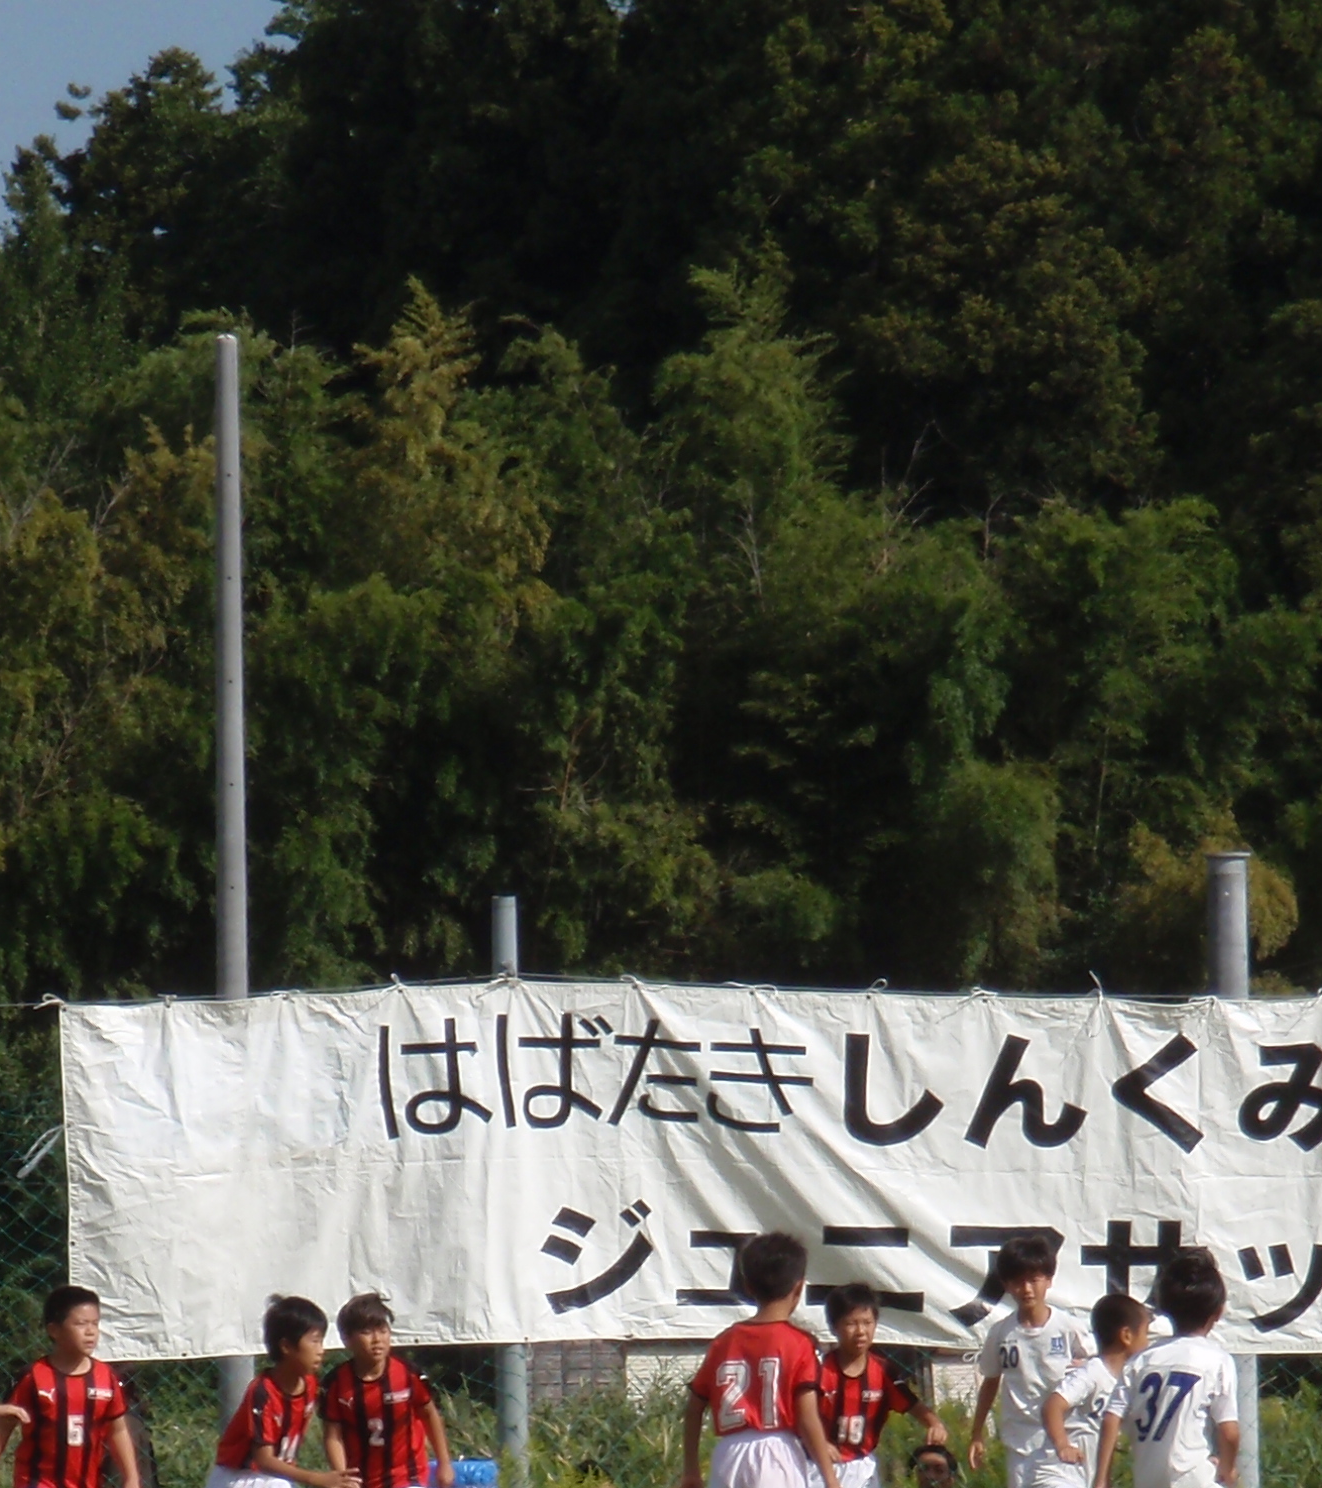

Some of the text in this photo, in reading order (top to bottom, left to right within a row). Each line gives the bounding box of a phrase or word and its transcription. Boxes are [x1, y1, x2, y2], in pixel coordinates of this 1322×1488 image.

[1000, 1345, 1020, 1368] 20
[716, 1358, 781, 1431] 21
[1135, 1371, 1202, 1442] 37
[67, 1414, 84, 1446] 5
[367, 1418, 385, 1446] 2
